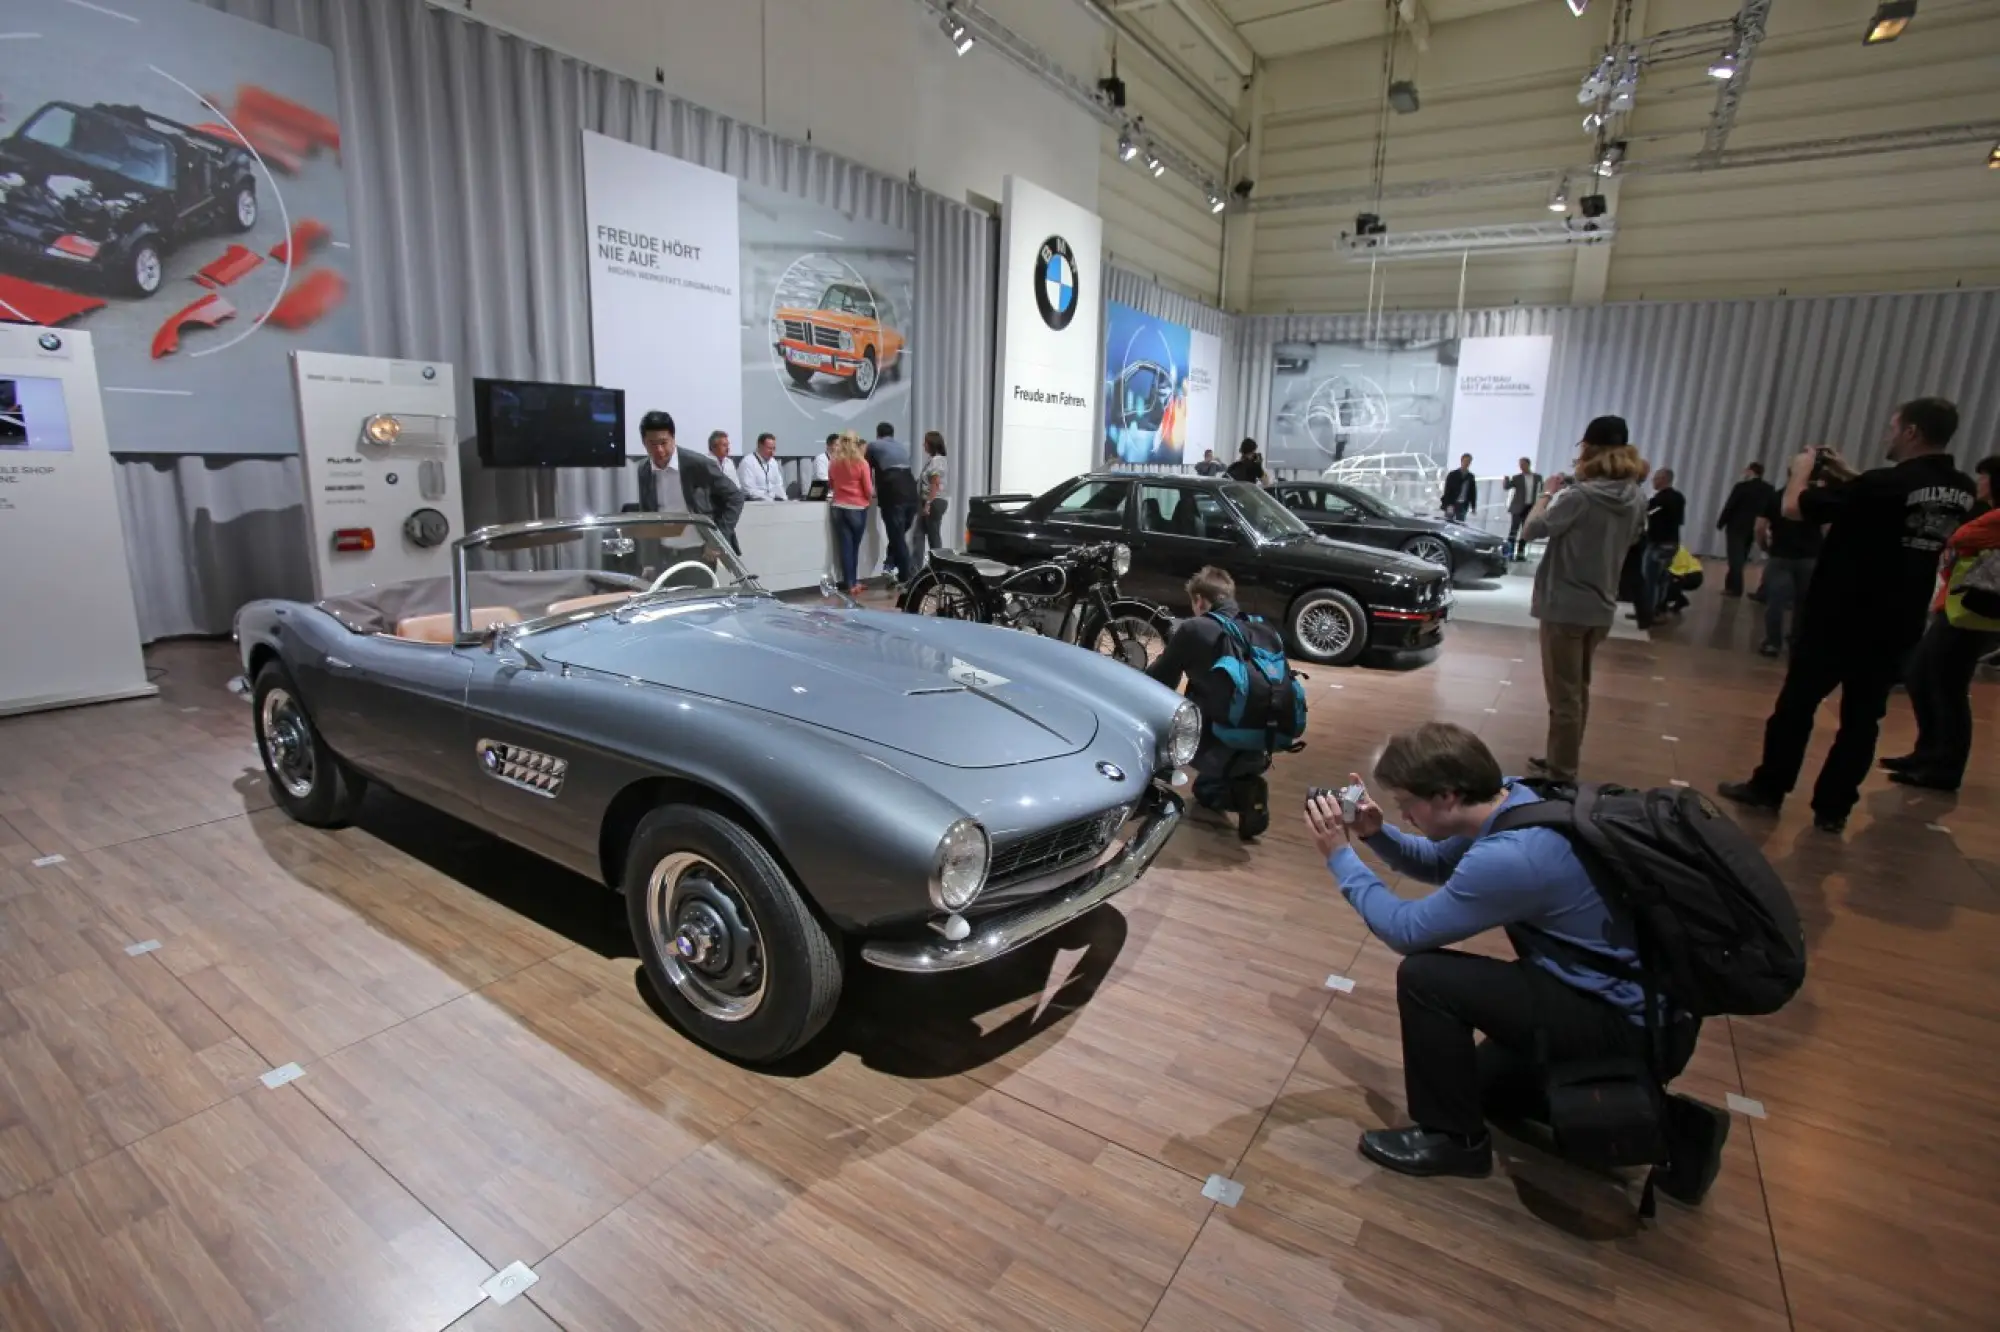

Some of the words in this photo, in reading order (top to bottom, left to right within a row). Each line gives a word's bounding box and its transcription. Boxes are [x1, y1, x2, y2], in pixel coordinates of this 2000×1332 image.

[597, 225, 659, 252] FREUDE
[662, 239, 701, 260] HÖRT
[598, 244, 624, 262] NIE
[628, 249, 661, 270] AUF.
[1013, 384, 1045, 403] Freude
[1045, 392, 1058, 404] am
[1059, 391, 1087, 408] Fahren.
[21, 466, 56, 475] SHOP
